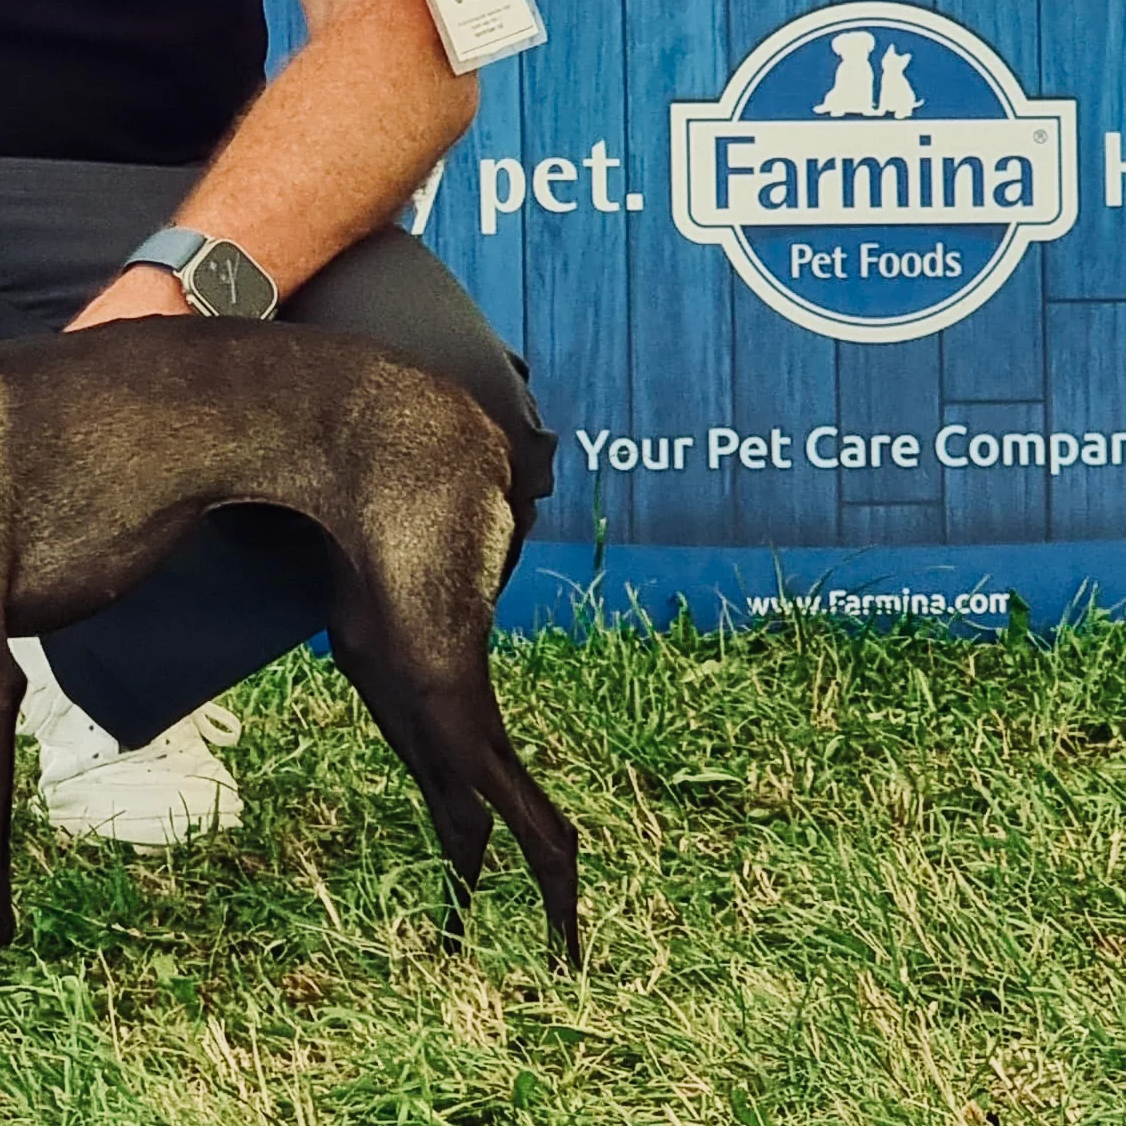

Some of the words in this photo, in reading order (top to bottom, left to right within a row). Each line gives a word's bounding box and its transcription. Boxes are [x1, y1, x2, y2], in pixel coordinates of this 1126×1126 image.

[479, 139, 644, 235] pet.
[714, 134, 1034, 210] Farmina
[790, 243, 848, 279] Pet
[859, 242, 962, 279] Foods
[575, 429, 693, 472] Your
[707, 428, 792, 470] Pet
[805, 426, 920, 469] Care
